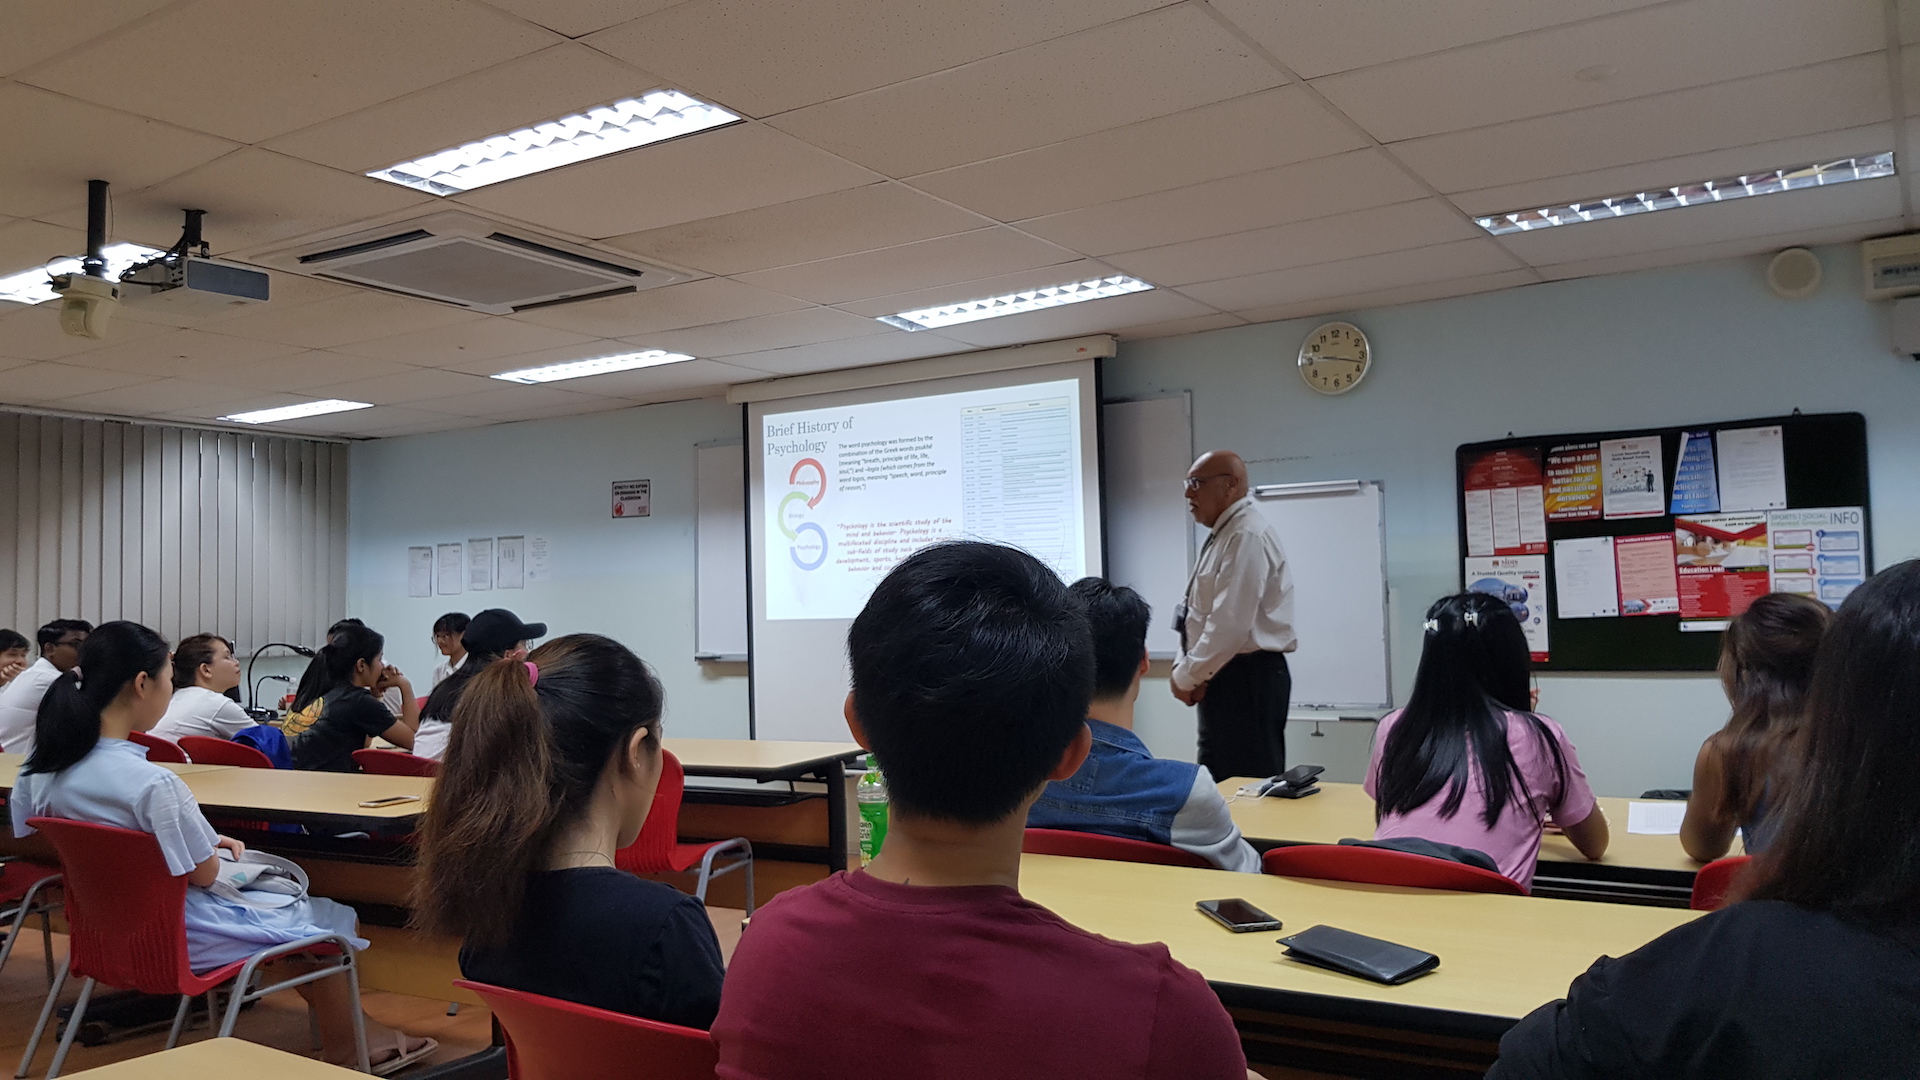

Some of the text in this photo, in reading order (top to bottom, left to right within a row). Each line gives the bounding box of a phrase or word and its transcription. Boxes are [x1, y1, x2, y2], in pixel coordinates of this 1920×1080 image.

[1330, 329, 1340, 338] 12
[1346, 331, 1349, 340] 1
[1320, 334, 1326, 344] 11
[1354, 338, 1360, 347] 2
[1312, 344, 1320, 352] 10
[1359, 350, 1364, 359] 3
[1355, 364, 1360, 372] 4
[1312, 369, 1318, 378] 8
[1346, 373, 1352, 382] 5
[1322, 377, 1327, 386] 7
[1334, 378, 1340, 387] 6
[767, 416, 854, 437] Brief History of
[768, 440, 827, 456] Psychology
[1575, 464, 1596, 473] lives
[1830, 512, 1859, 524] INFO
